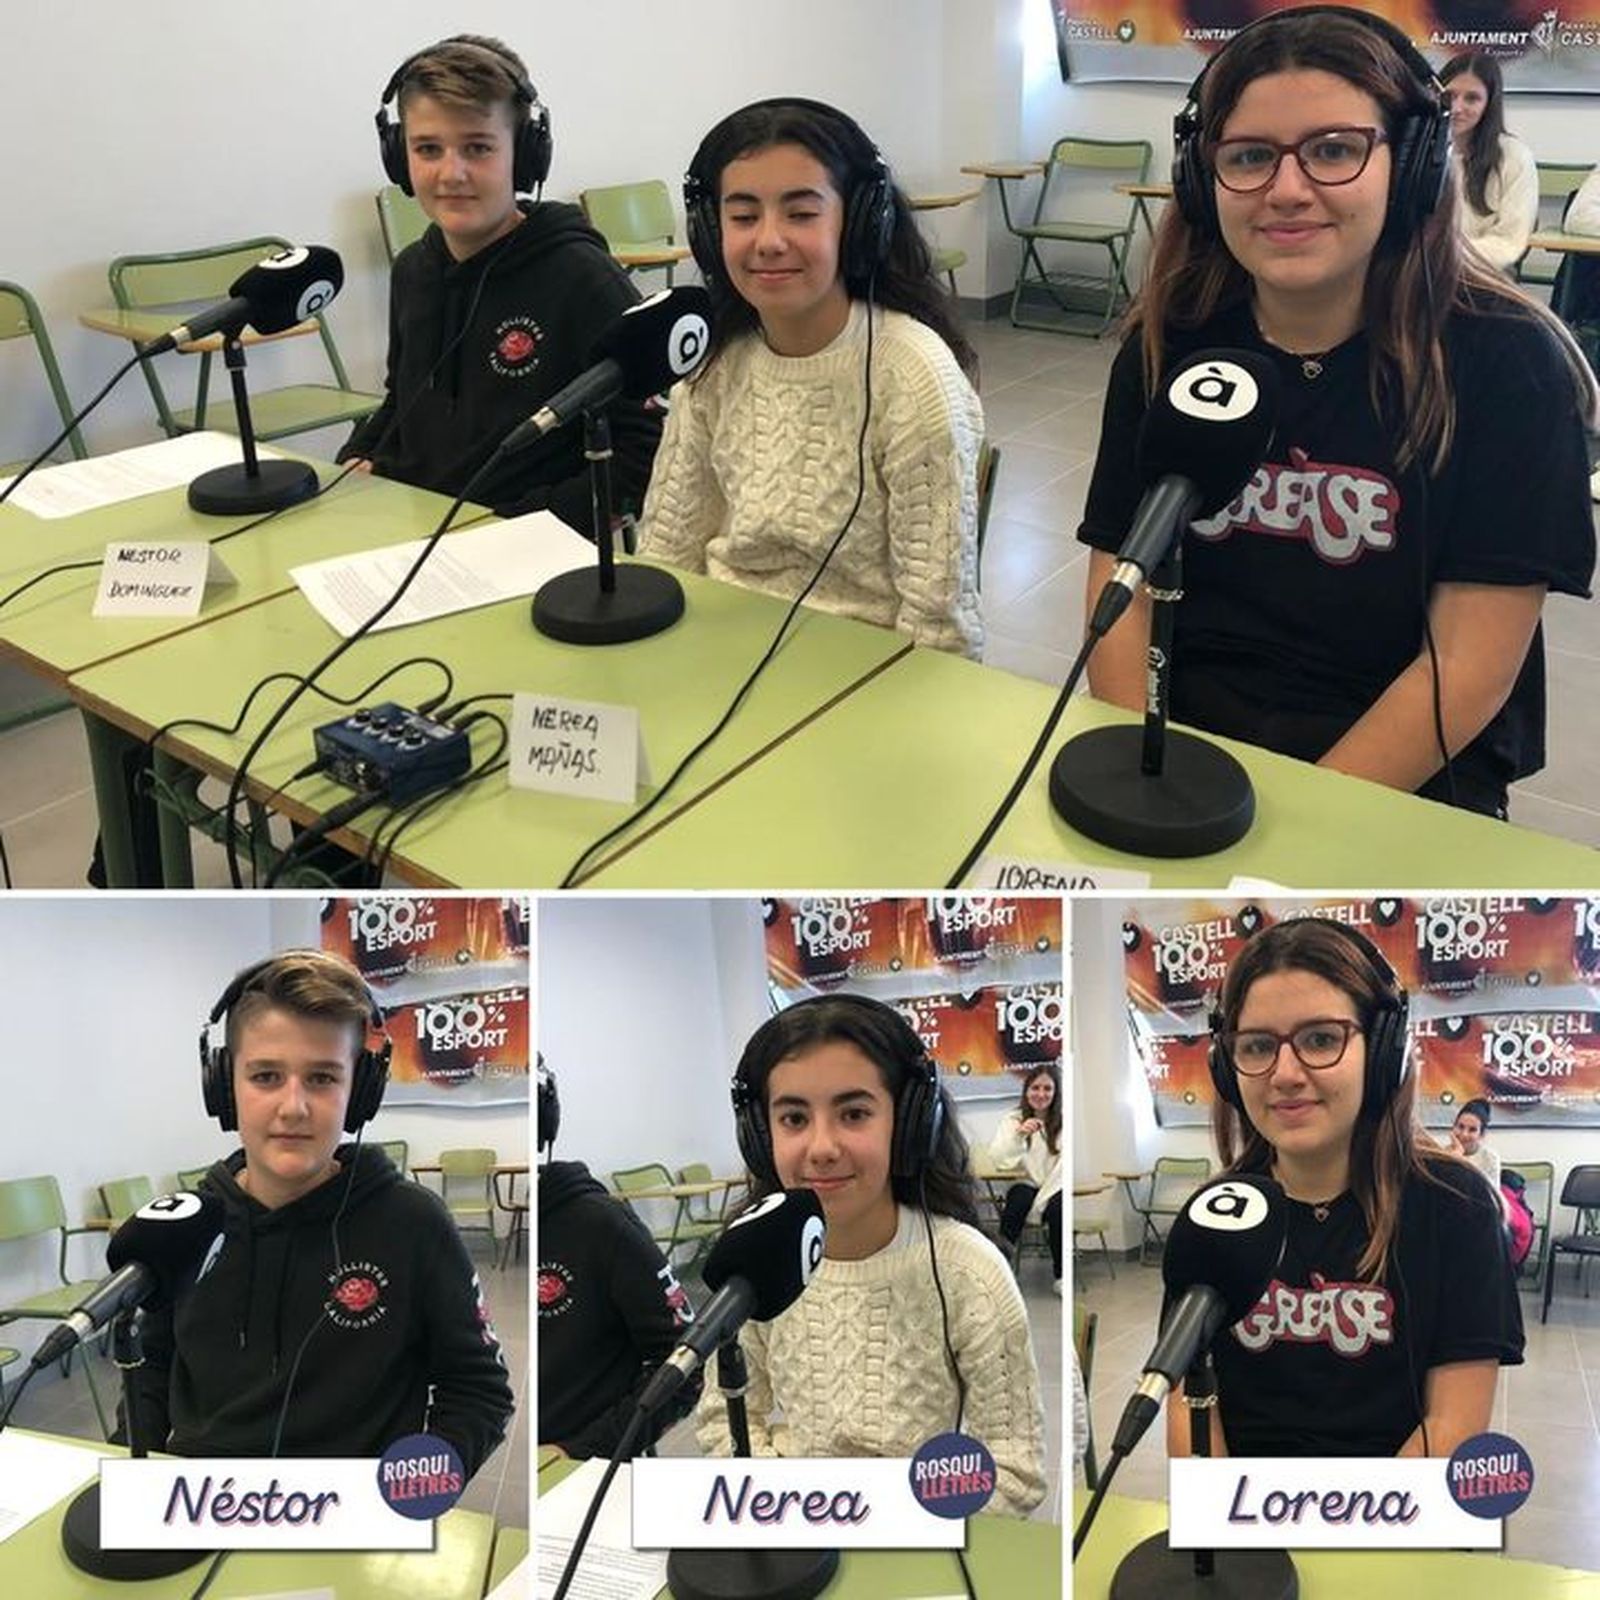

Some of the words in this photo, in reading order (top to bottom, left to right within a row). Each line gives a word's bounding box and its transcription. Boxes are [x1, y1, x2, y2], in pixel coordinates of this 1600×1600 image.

[1430, 31, 1529, 46] AJUNTAMENT
[943, 906, 1017, 933] ESPORT
[1426, 897, 1525, 918] CASTELL
[366, 920, 438, 953] ESPORT
[790, 908, 869, 947] 100%
[1160, 917, 1236, 945] CASTELL
[1416, 915, 1507, 950] 100%
[810, 929, 872, 957] ESPORT
[1432, 939, 1509, 962] ESPORT
[1152, 942, 1224, 973] 100%
[1168, 962, 1228, 984] ESPORT
[415, 1005, 506, 1040] 100%
[1494, 1014, 1592, 1036] CASTELL
[432, 1028, 508, 1051] ESPORT
[1482, 1033, 1575, 1065] 100%
[1498, 1058, 1578, 1077] ESPORT
